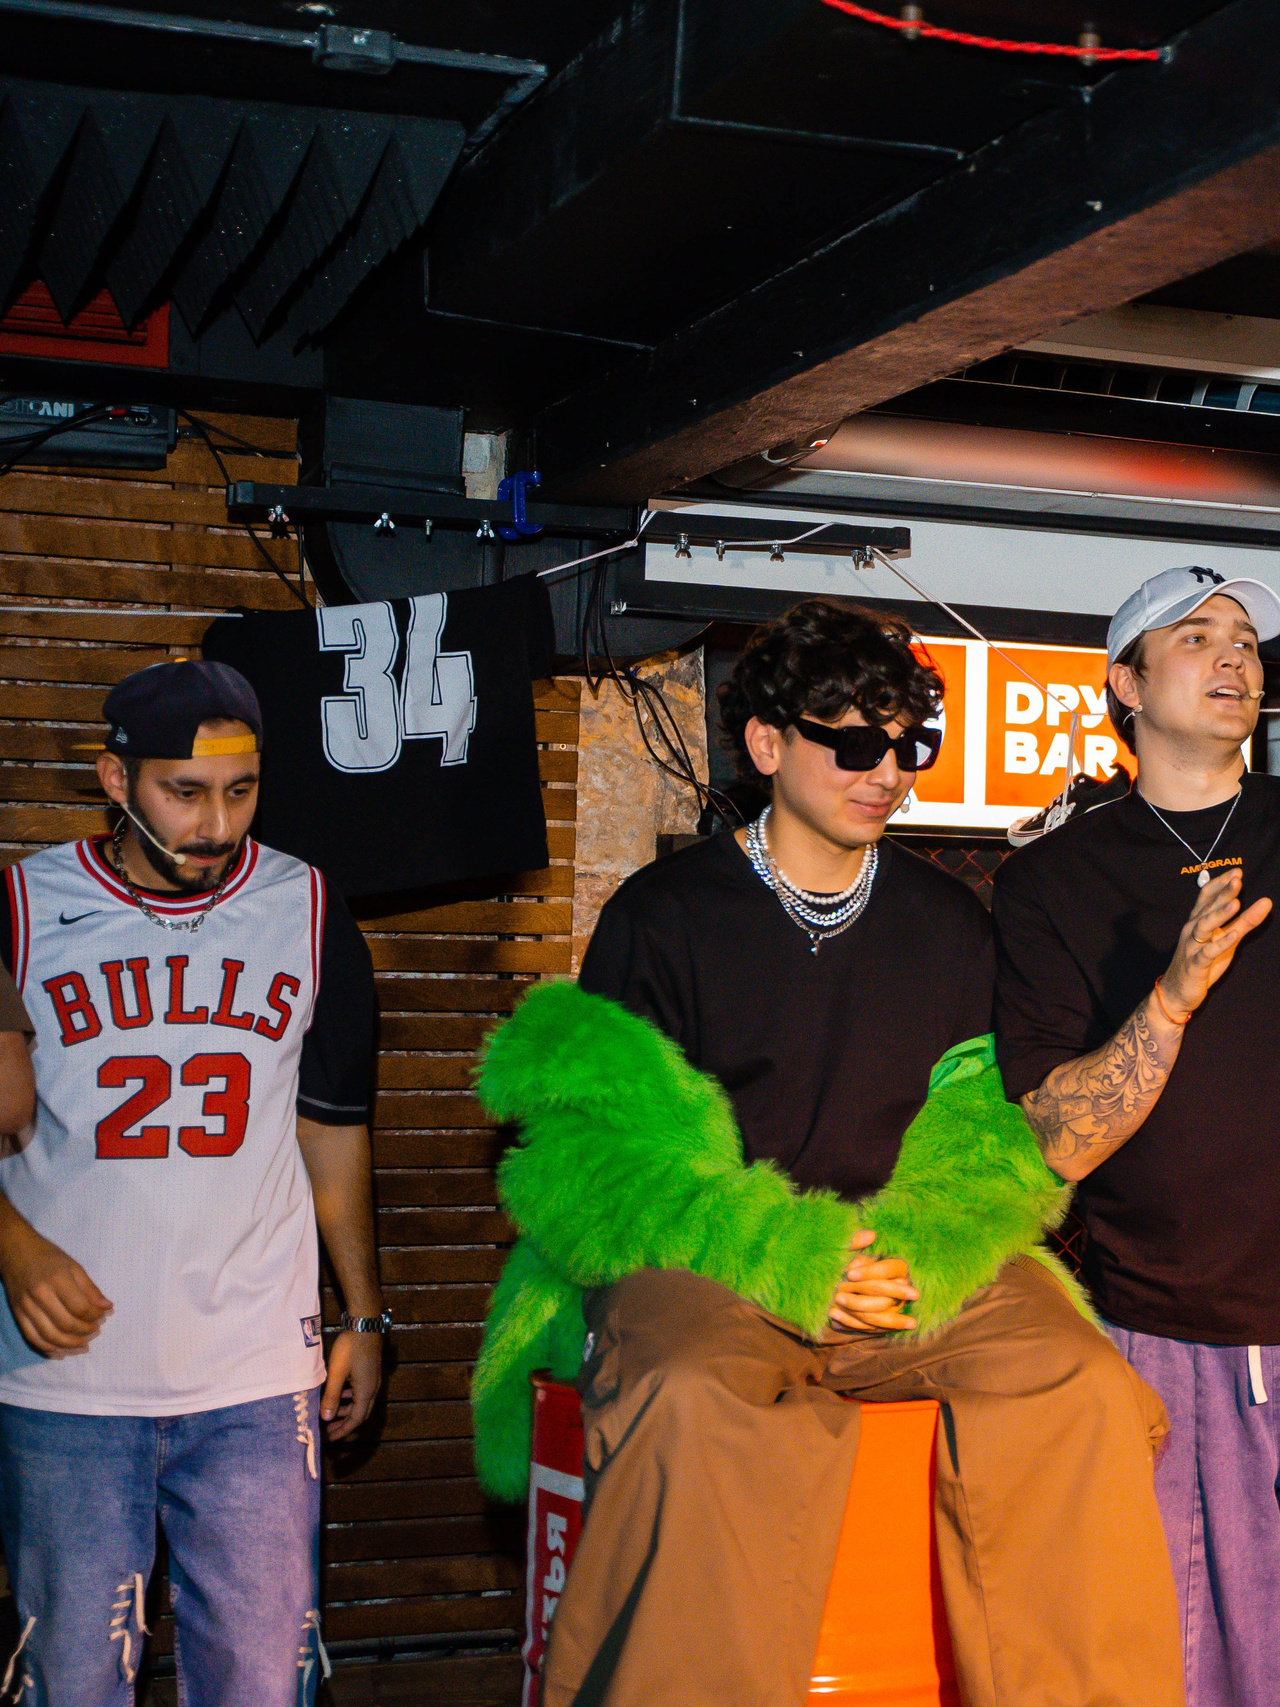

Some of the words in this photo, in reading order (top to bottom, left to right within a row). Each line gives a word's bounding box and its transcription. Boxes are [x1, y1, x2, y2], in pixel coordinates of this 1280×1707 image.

[316, 592, 478, 774] 34
[1005, 681, 1108, 729] DРУ
[1004, 730, 1119, 778] BAR
[41, 955, 301, 1048] BULLS
[95, 1052, 252, 1160] 23
